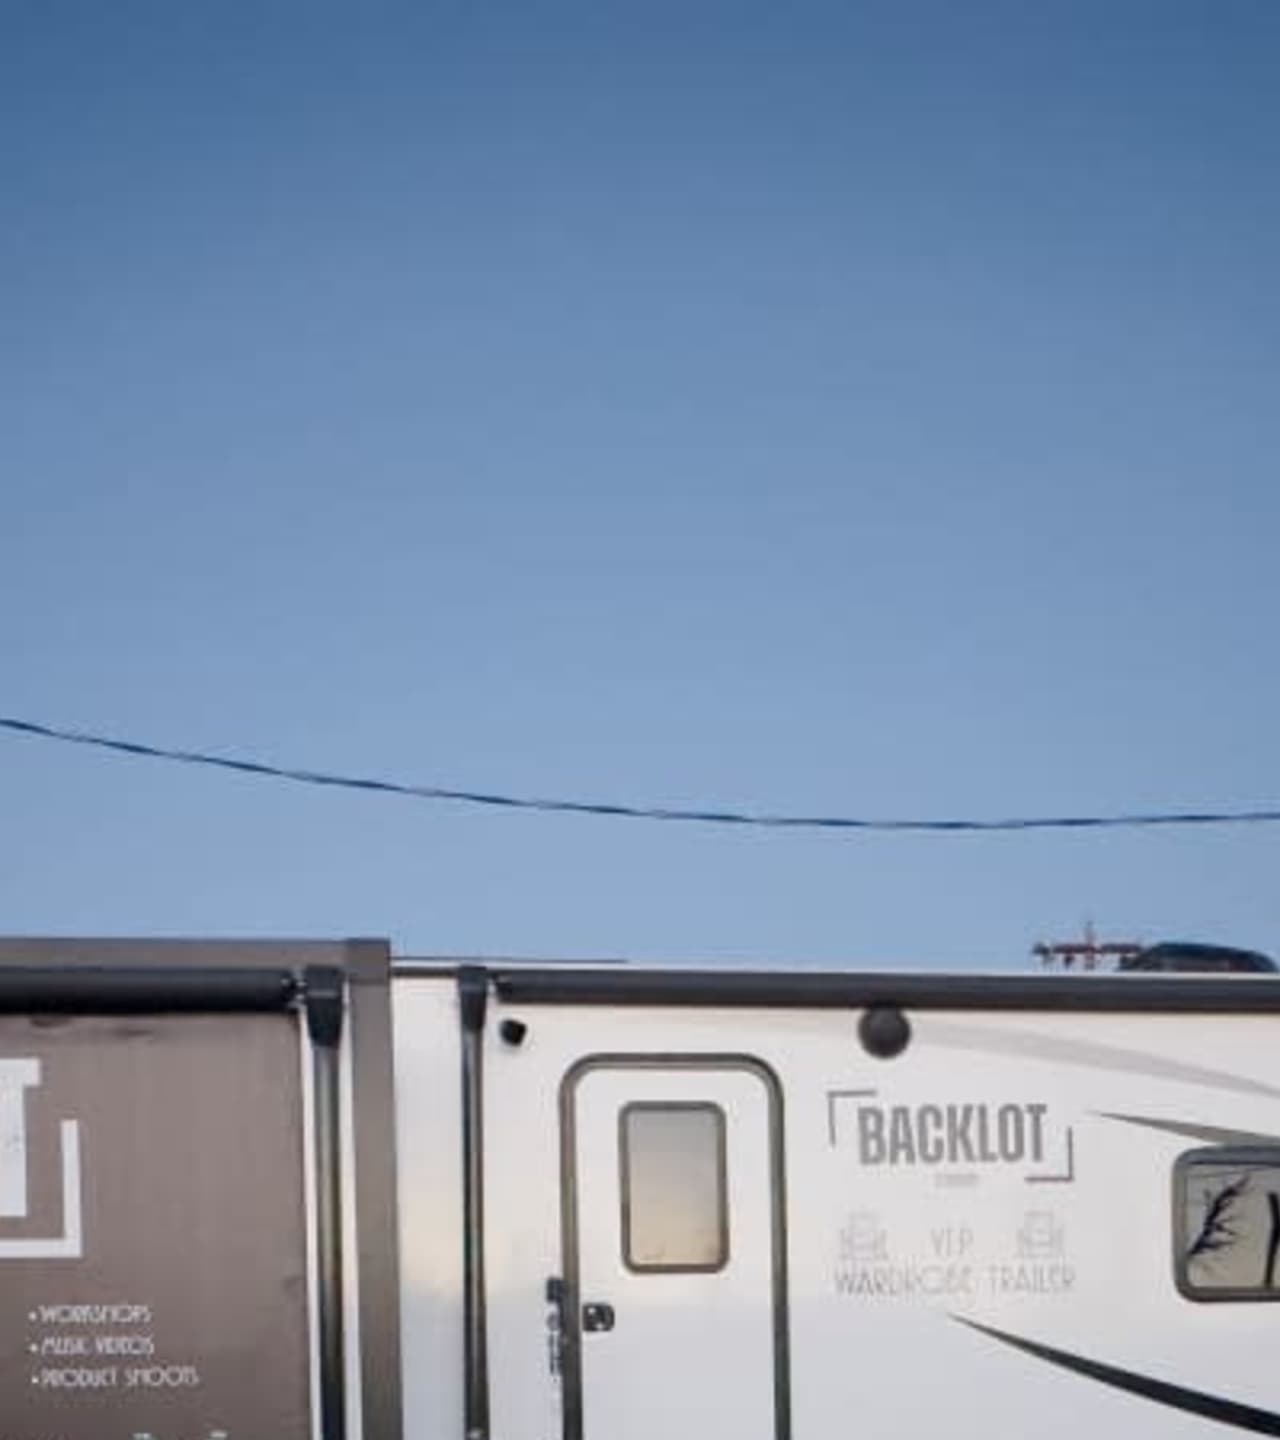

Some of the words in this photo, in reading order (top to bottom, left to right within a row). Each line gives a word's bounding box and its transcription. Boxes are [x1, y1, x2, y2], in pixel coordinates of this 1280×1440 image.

[857, 1103, 1048, 1166] BACKLOT
[834, 1261, 976, 1298] WARDROBE
[989, 1261, 1077, 1296] TRAILER
[37, 1304, 152, 1324] WORKSHOPS
[41, 1336, 89, 1356] MUSIC
[95, 1334, 156, 1356] VIDEOS
[41, 1367, 117, 1389] PRODUCT
[124, 1365, 201, 1387] SHOOTS
